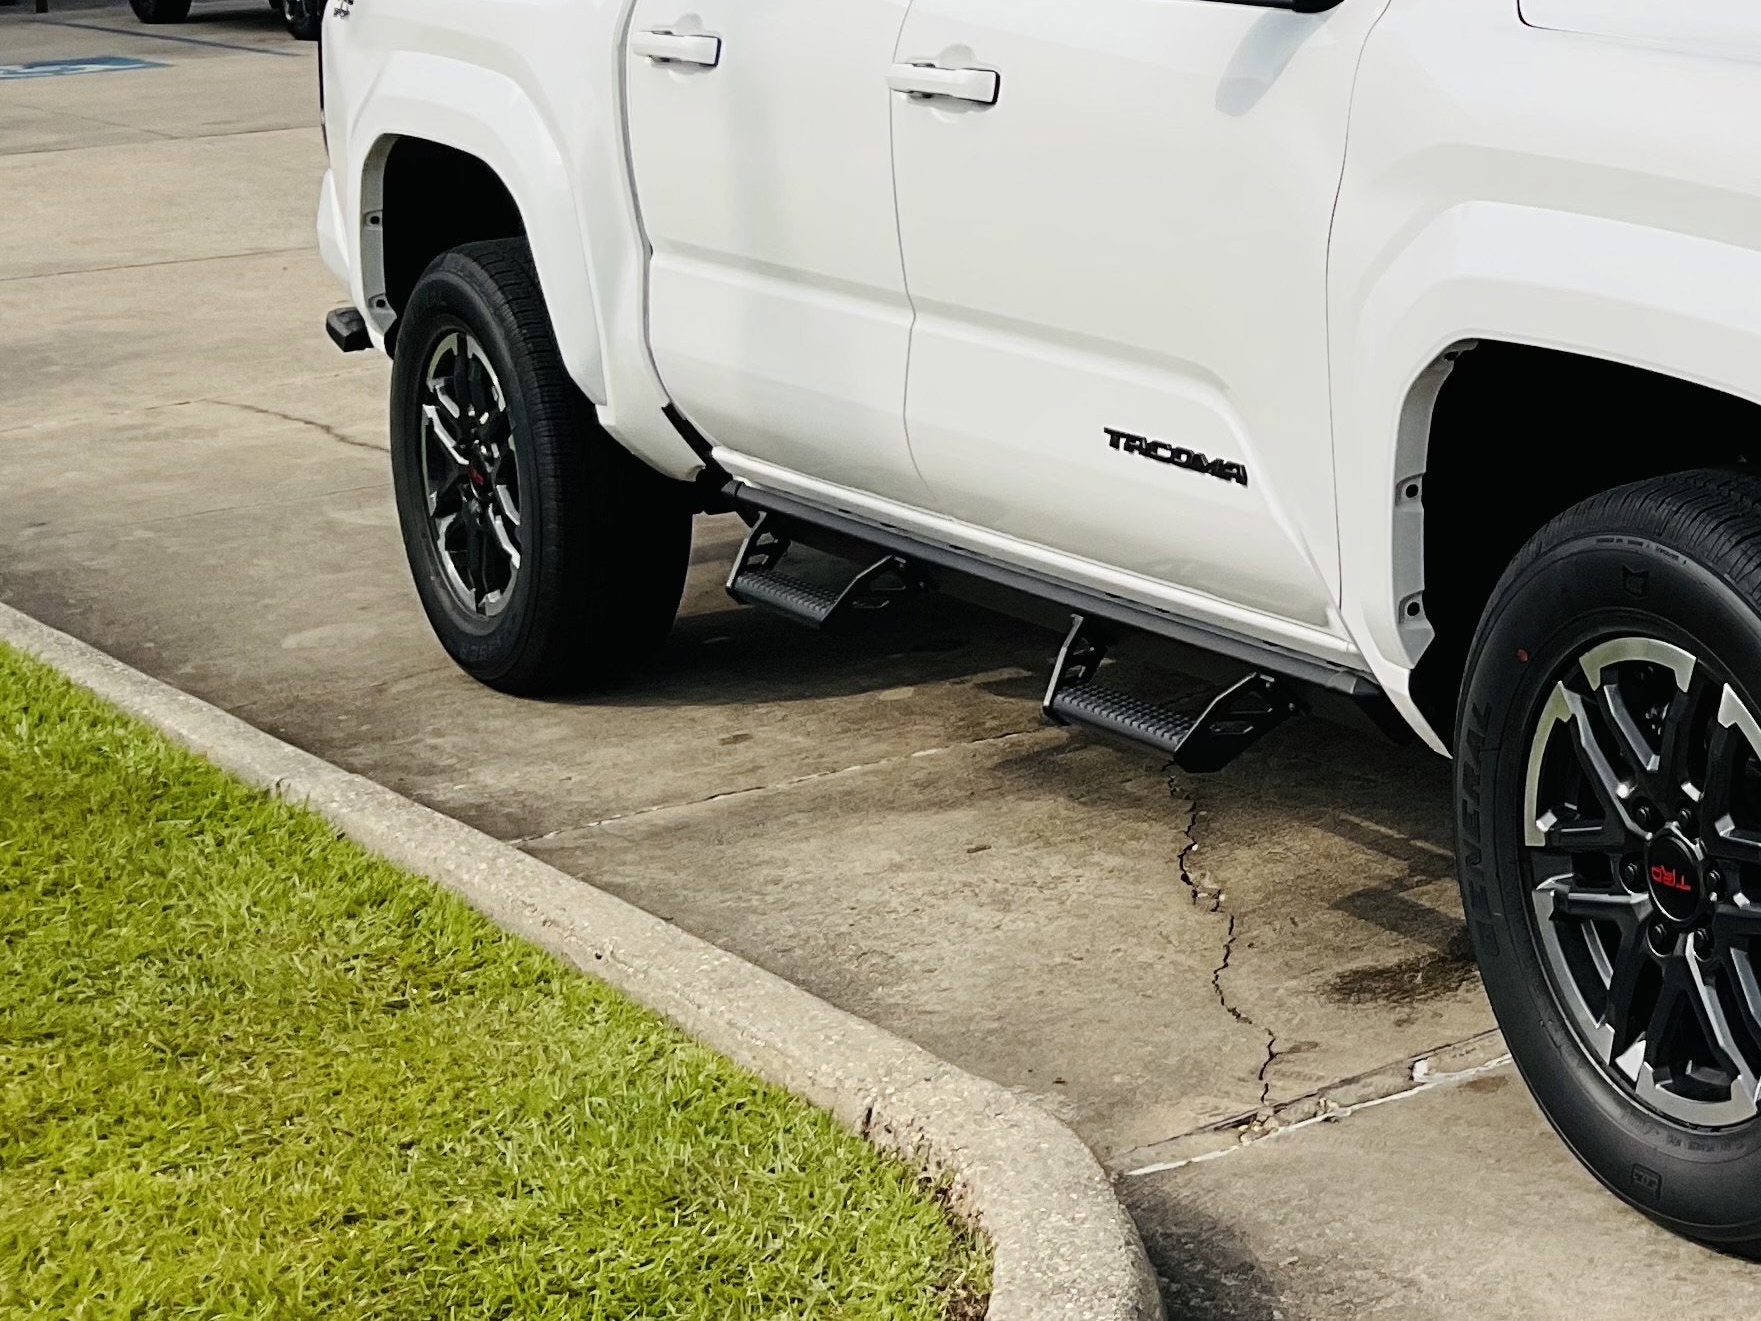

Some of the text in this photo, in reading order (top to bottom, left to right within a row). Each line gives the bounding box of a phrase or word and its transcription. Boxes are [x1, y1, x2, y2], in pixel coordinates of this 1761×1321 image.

[1103, 426, 1249, 488] TACOMA
[1463, 701, 1501, 959] GENERAL
[1651, 864, 1692, 892] TRD
